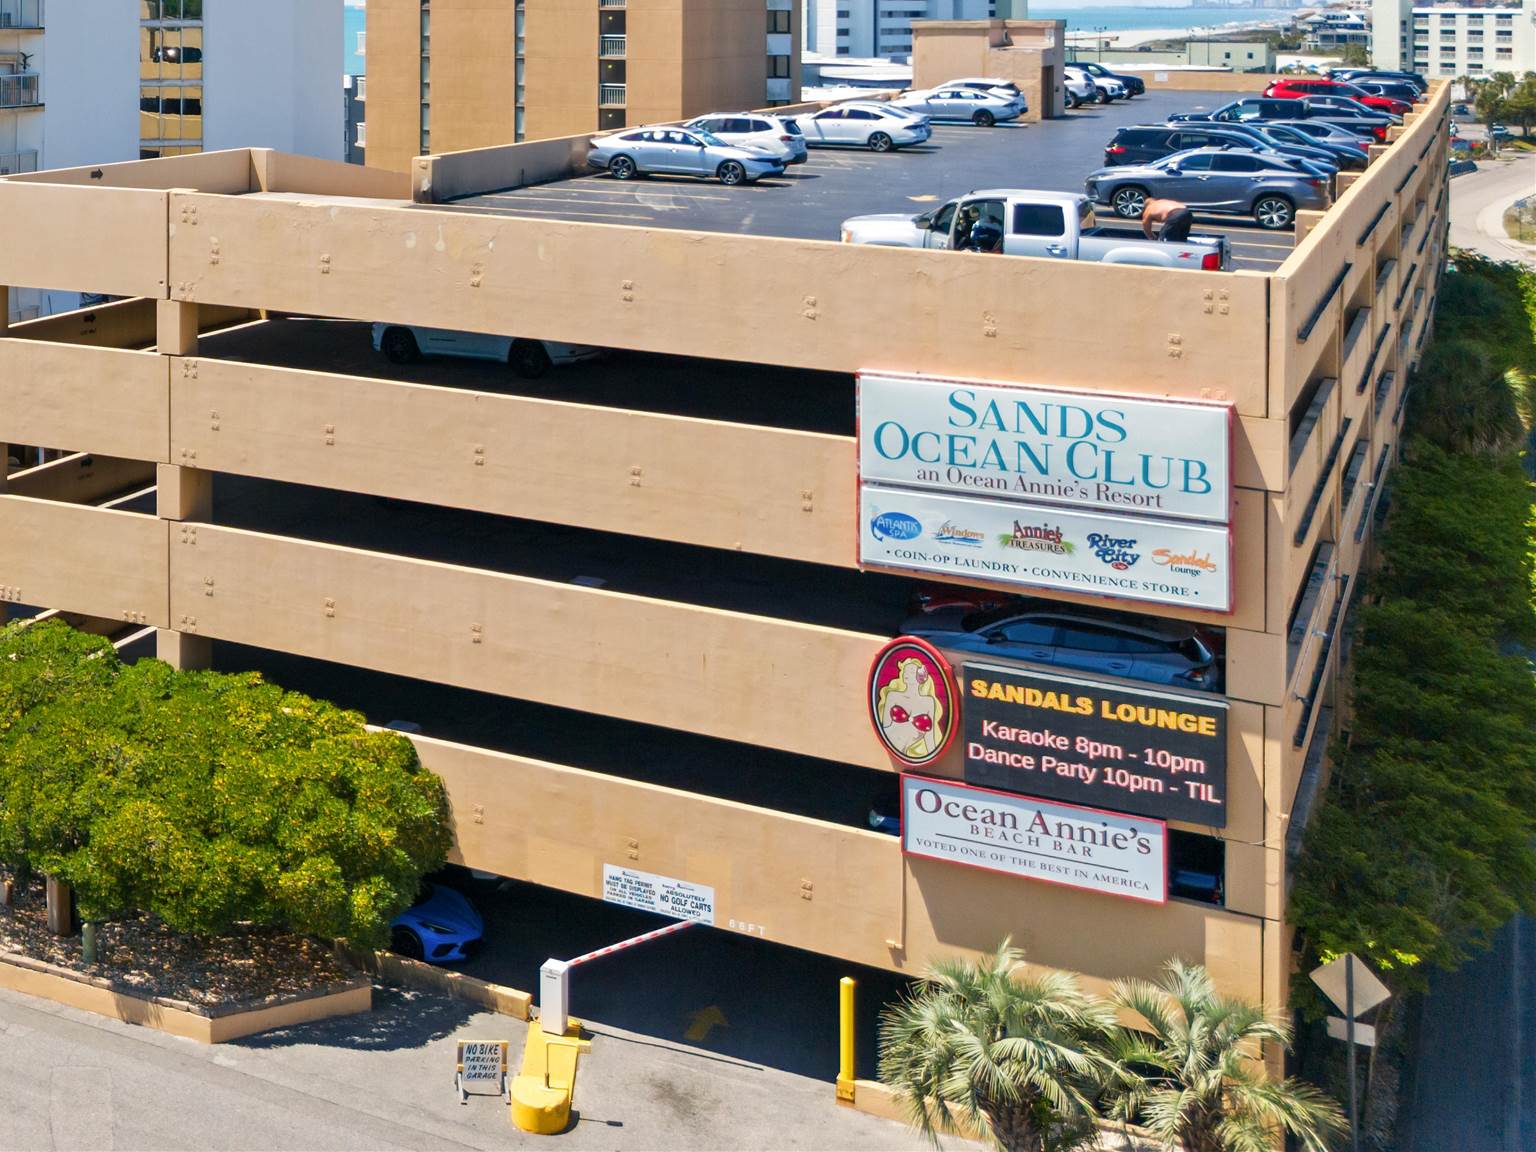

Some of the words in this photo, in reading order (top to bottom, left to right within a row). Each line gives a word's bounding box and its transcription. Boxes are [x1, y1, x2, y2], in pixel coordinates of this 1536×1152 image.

[948, 389, 1127, 443] SANDS
[874, 421, 1050, 476] OCEAN
[1066, 441, 1212, 495] CLUB
[916, 468, 940, 482] an
[947, 466, 1007, 491] Ocean
[1014, 475, 1089, 501] Annie's
[1096, 483, 1163, 508] Resort
[876, 516, 918, 533] ATLANTIS
[889, 530, 907, 538] SPA
[1087, 533, 1137, 549] River
[894, 549, 950, 564] COIN-OP
[955, 557, 1019, 573] LAUNDRY
[1032, 567, 1138, 589] CONVENIENCE
[1142, 581, 1190, 596] STORE
[1095, 548, 1141, 565] City
[1170, 565, 1201, 577] Lounge
[971, 679, 1093, 716] SANDALS
[1102, 699, 1217, 737] LOUNGE
[982, 720, 1070, 750] Karaoke
[1076, 736, 1122, 762] 8pm
[1144, 748, 1206, 776] 10pm
[968, 742, 1035, 770] Dance
[1042, 756, 1097, 785] Party
[1103, 766, 1164, 795] 10pm
[1185, 781, 1221, 804] TIL
[915, 788, 1017, 829] Ocean
[1028, 809, 1152, 856] Annie's
[970, 825, 1042, 848] BEACH
[1053, 840, 1093, 858] BAR
[916, 837, 957, 853] VOTED
[960, 848, 987, 859] ONE
[990, 852, 1007, 863] OF
[1010, 856, 1035, 869] THE
[1039, 861, 1071, 875] BEST
[1074, 868, 1089, 879] IN
[1092, 872, 1150, 892] AMERICA
[660, 894, 669, 902] NO
[672, 896, 688, 907] GOLF
[690, 901, 711, 913] CARTS
[665, 889, 706, 902] ABSOLUTELY
[671, 905, 701, 917] ALLOWED
[466, 1044, 477, 1055] NO
[479, 1044, 499, 1055] BIKE
